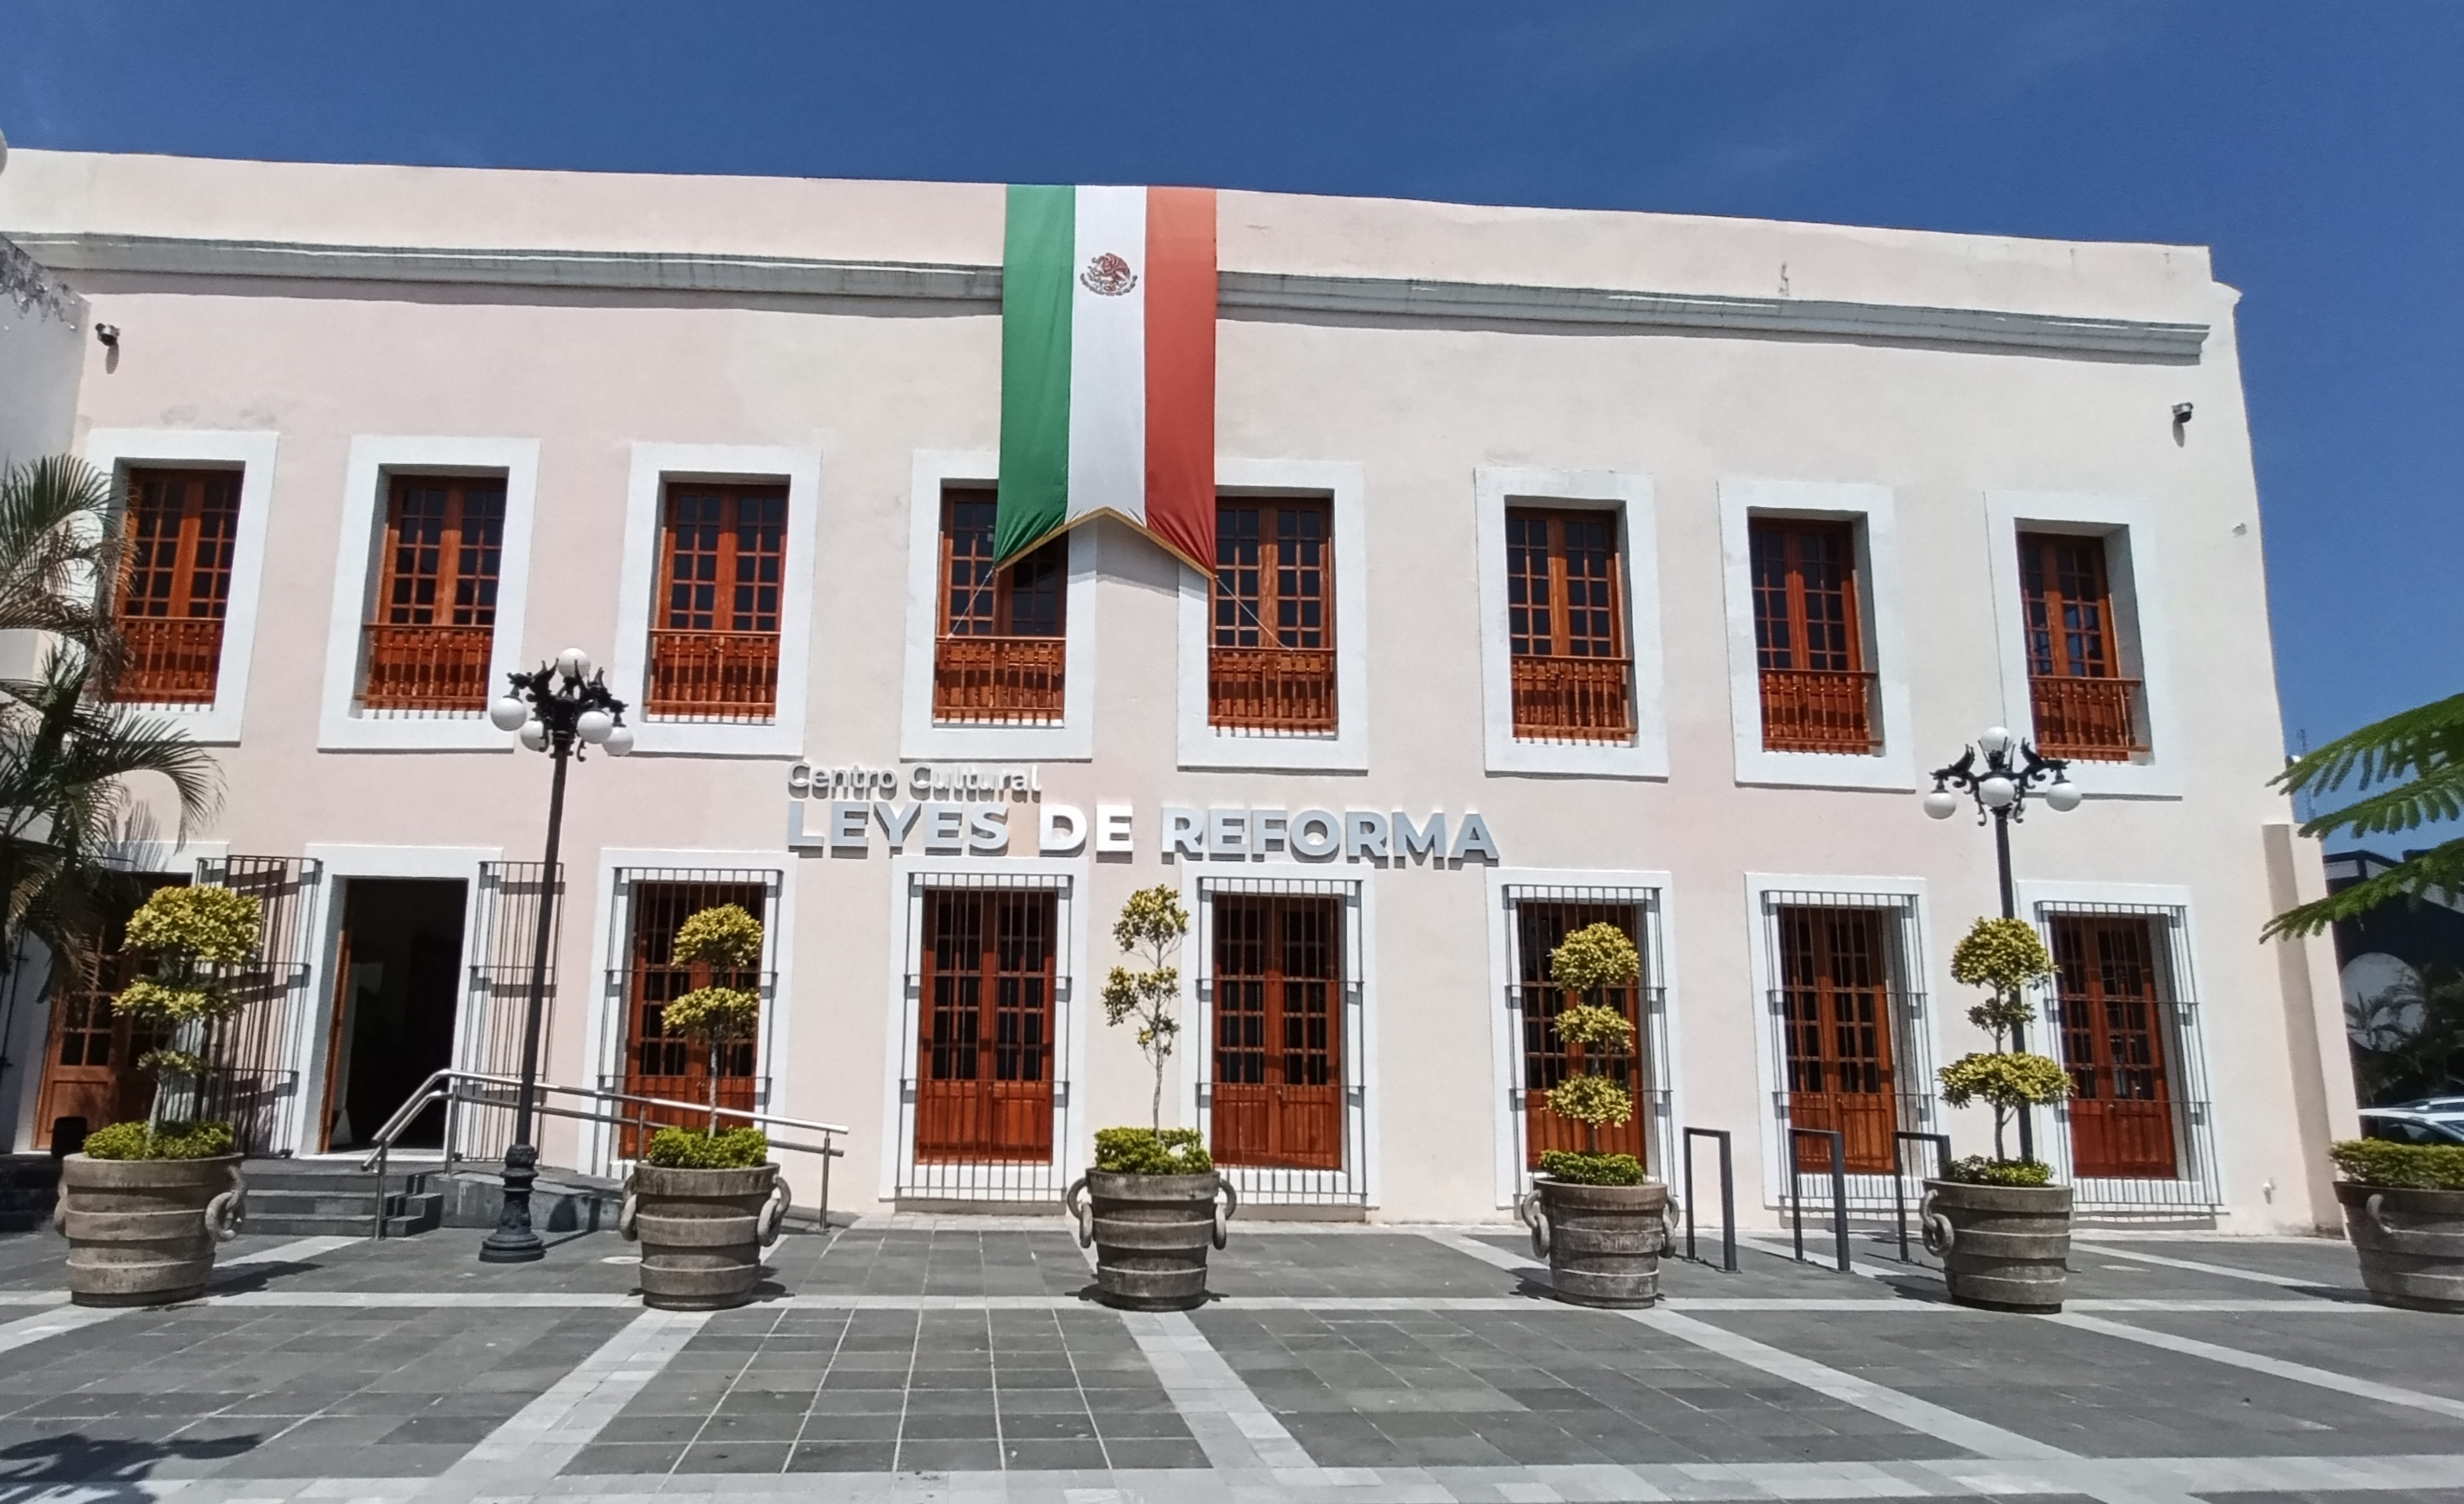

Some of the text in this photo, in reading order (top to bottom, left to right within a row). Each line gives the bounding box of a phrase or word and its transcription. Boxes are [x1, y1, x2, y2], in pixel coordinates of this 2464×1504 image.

[787, 761, 1043, 792] Centro Cultural
[787, 801, 1501, 860] LEYES DE REFORMA
